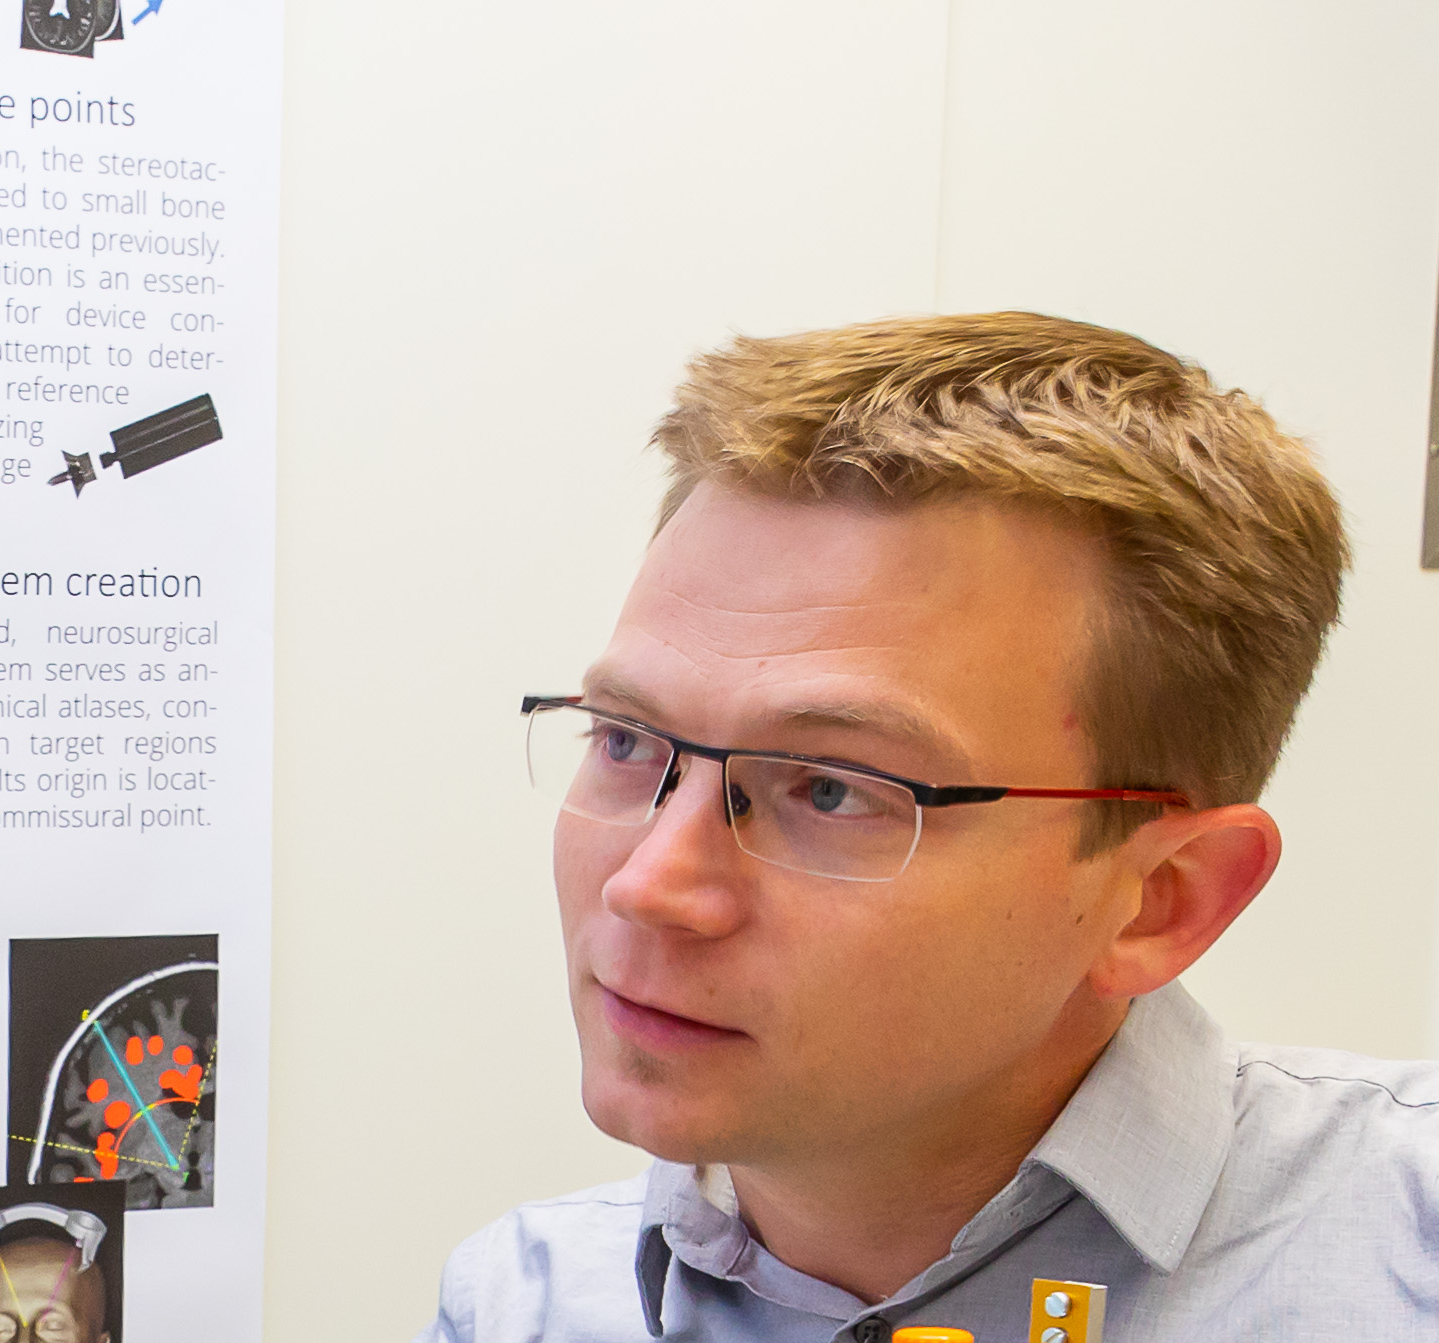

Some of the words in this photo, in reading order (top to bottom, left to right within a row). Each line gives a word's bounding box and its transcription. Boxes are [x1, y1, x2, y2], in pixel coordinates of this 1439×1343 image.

[30, 90, 136, 129] points
[41, 145, 84, 173] the
[97, 153, 226, 182] stereotac-
[41, 187, 68, 211] to
[81, 189, 147, 215] small
[161, 191, 226, 221] bone
[91, 229, 225, 265] previously.
[67, 263, 86, 289] is
[98, 270, 129, 291] an
[143, 273, 225, 295] essen-
[4, 297, 42, 325] for
[66, 300, 147, 330] device
[170, 312, 225, 333] con-
[65, 566, 202, 599] creation
[47, 620, 218, 653] neurosurgical
[44, 662, 126, 682] serves
[138, 663, 166, 682] as
[177, 663, 219, 682] an-
[58, 692, 151, 722] atlases,
[162, 699, 218, 719] con-
